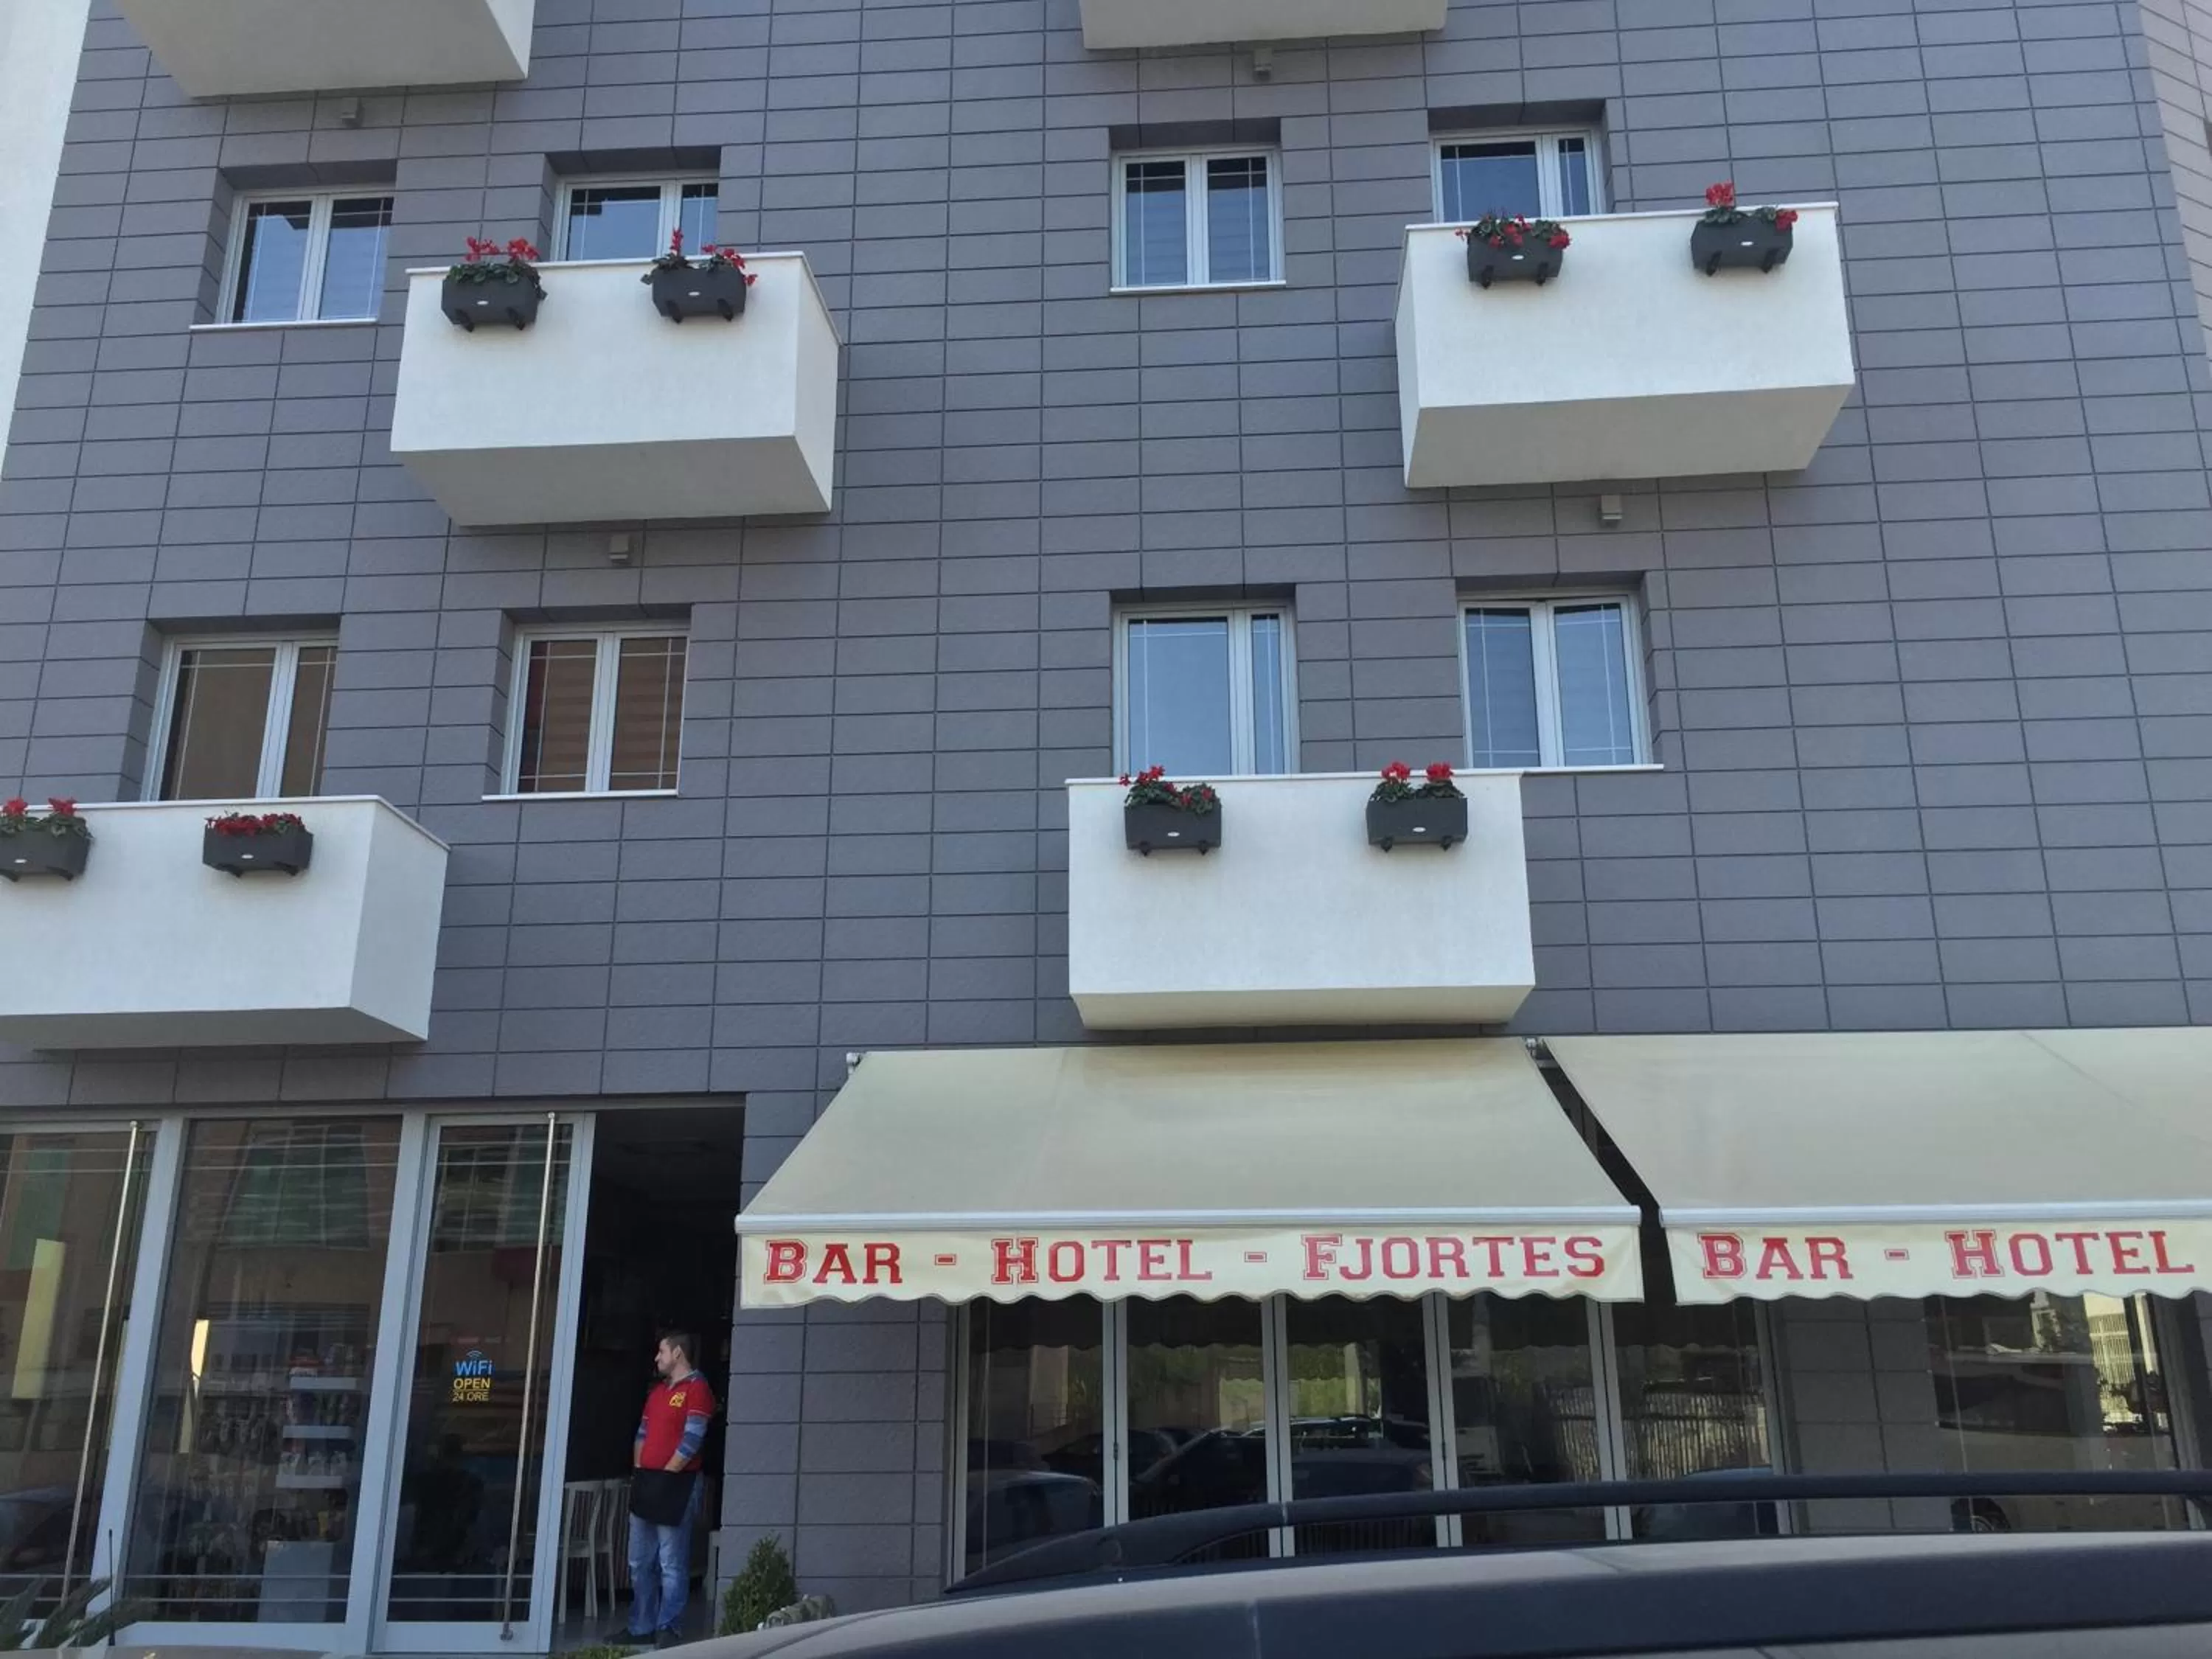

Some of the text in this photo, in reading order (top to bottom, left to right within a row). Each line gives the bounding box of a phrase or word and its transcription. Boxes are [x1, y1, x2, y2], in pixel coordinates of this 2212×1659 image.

[763, 1238, 903, 1287] BAR
[991, 1237, 1211, 1285] HOTEL
[1301, 1234, 1606, 1281] FJORTES
[1697, 1232, 1854, 1280] BAR
[1944, 1228, 2196, 1279] HOTEL
[456, 1360, 493, 1375] WiFi
[453, 1377, 491, 1390] OPEN
[452, 1391, 490, 1402] 24 ORE
